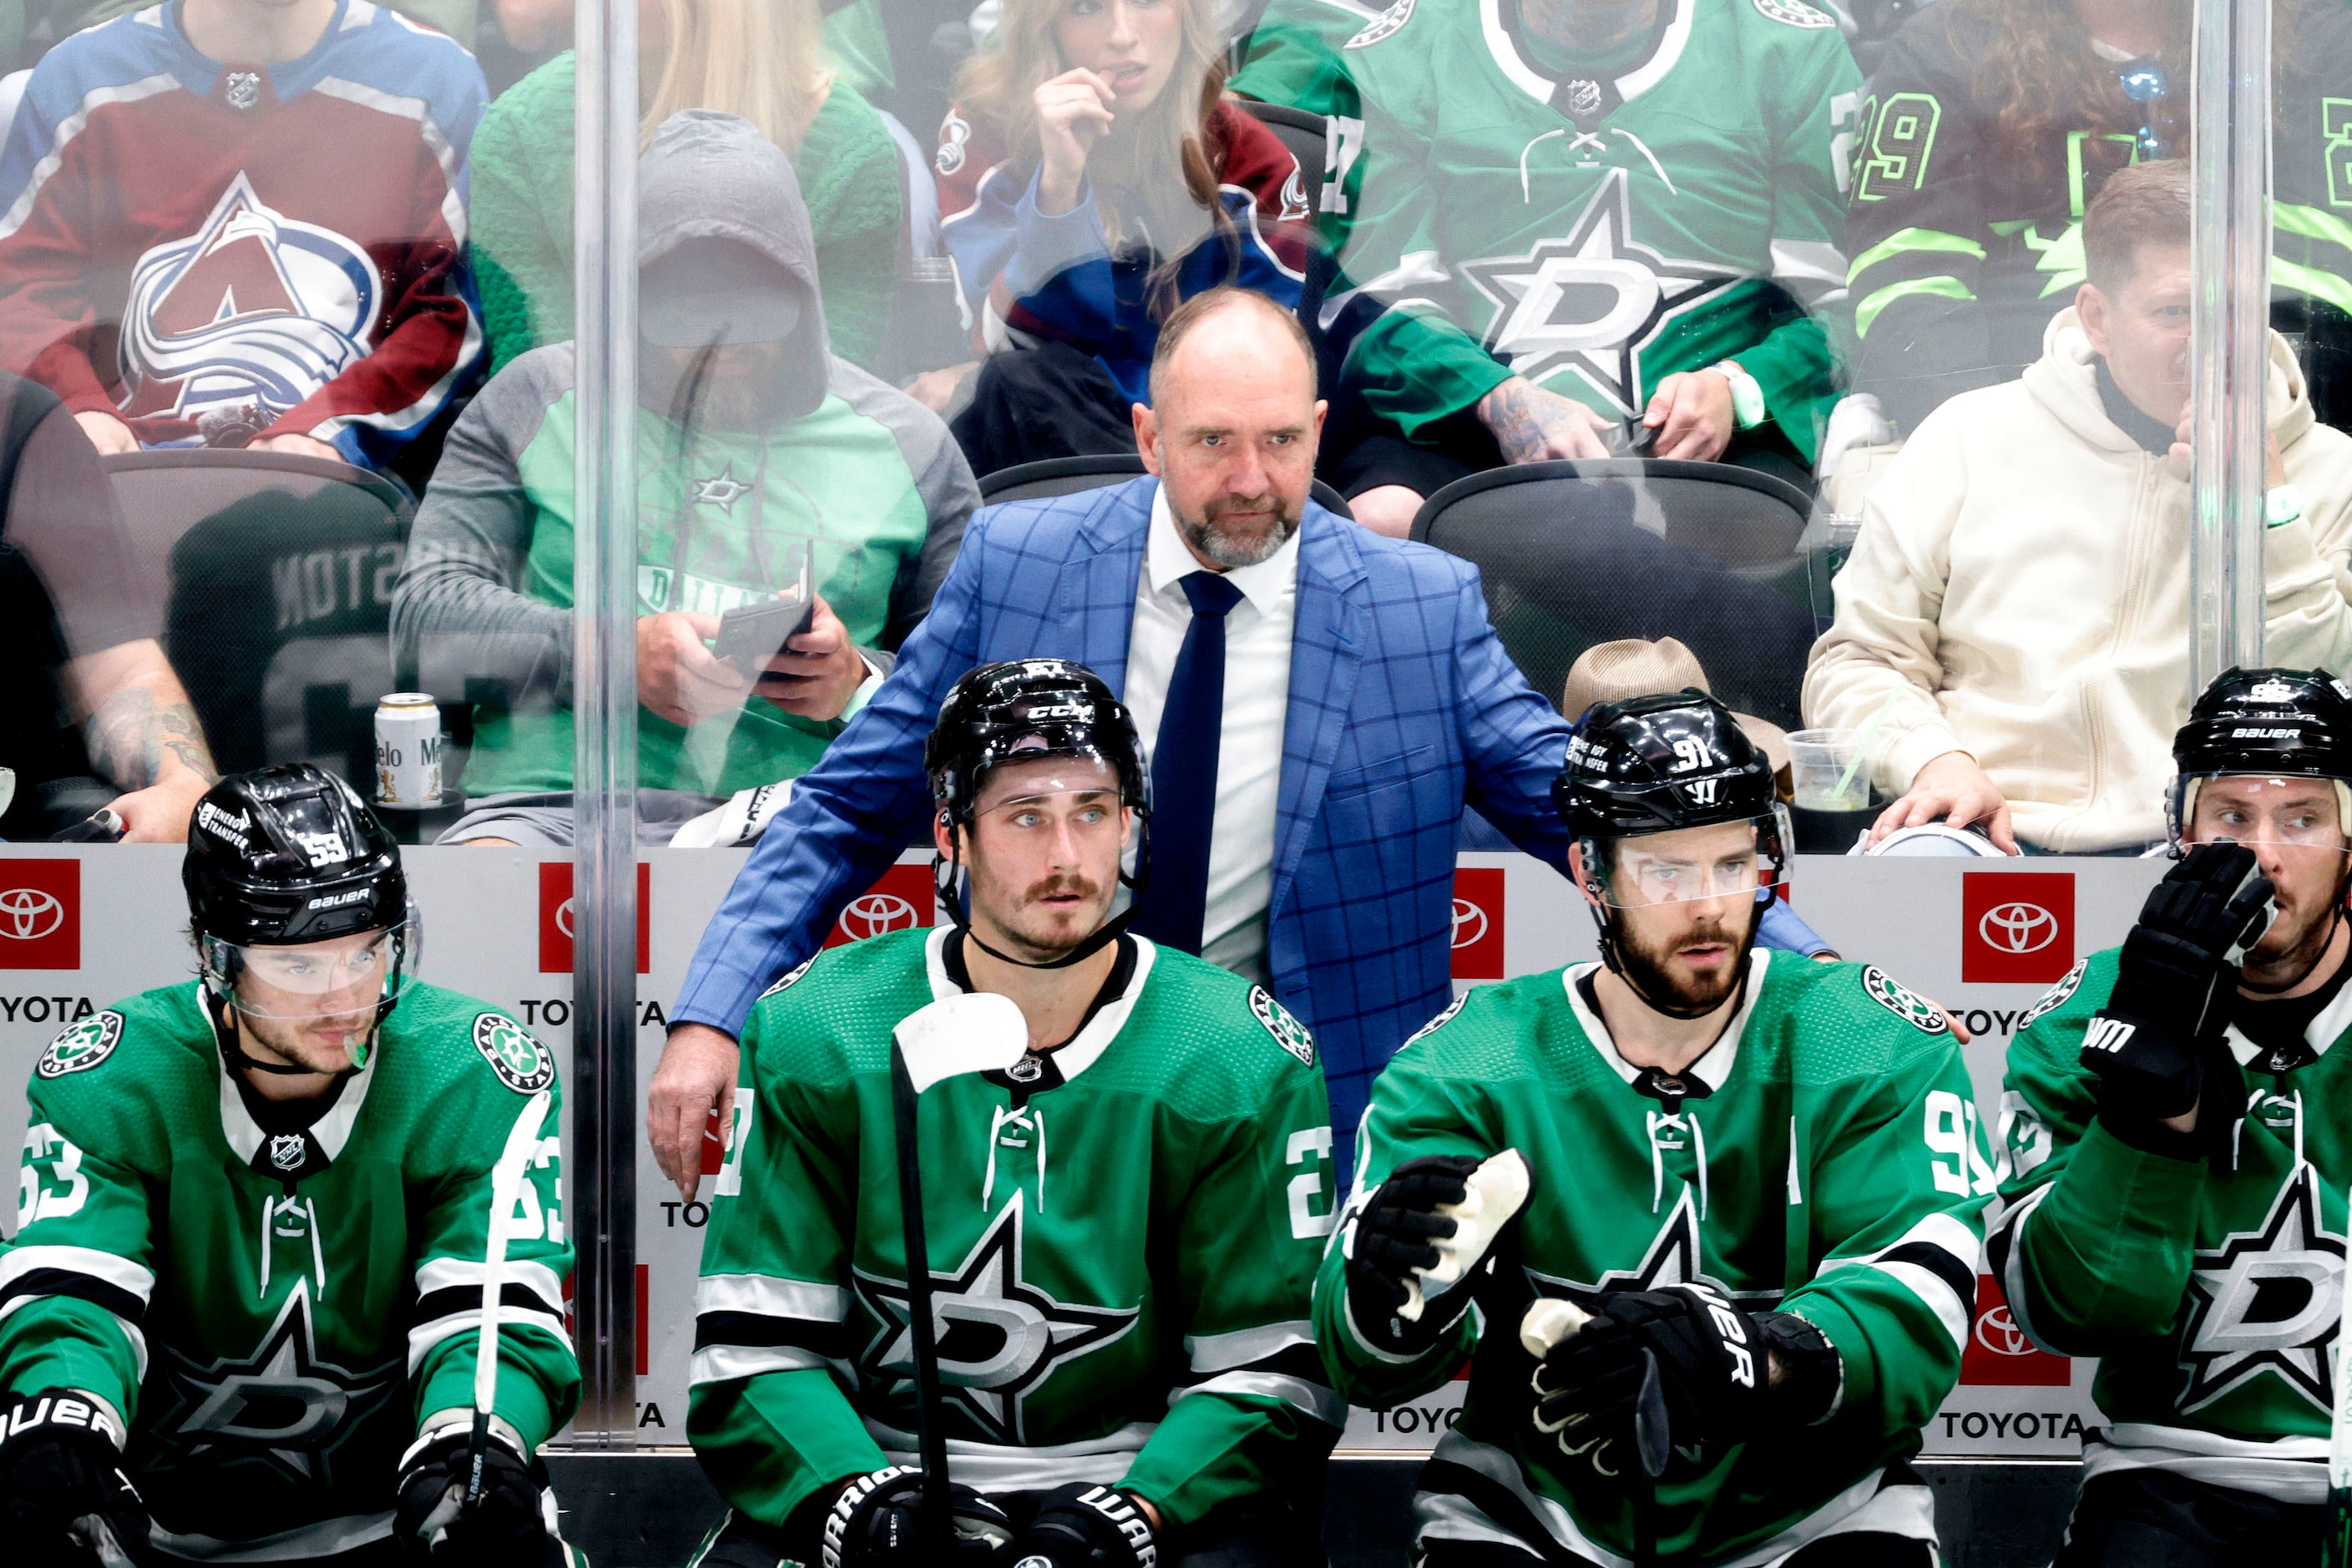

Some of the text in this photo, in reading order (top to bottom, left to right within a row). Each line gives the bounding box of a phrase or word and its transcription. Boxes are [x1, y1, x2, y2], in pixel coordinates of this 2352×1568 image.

[2231, 728, 2301, 739] BAUER
[1672, 734, 1713, 772] 91
[208, 819, 249, 850] TRANSFER
[308, 888, 370, 910] BAUER
[1924, 1090, 1997, 1199] 91
[1939, 1412, 2086, 1439] TOYOTA
